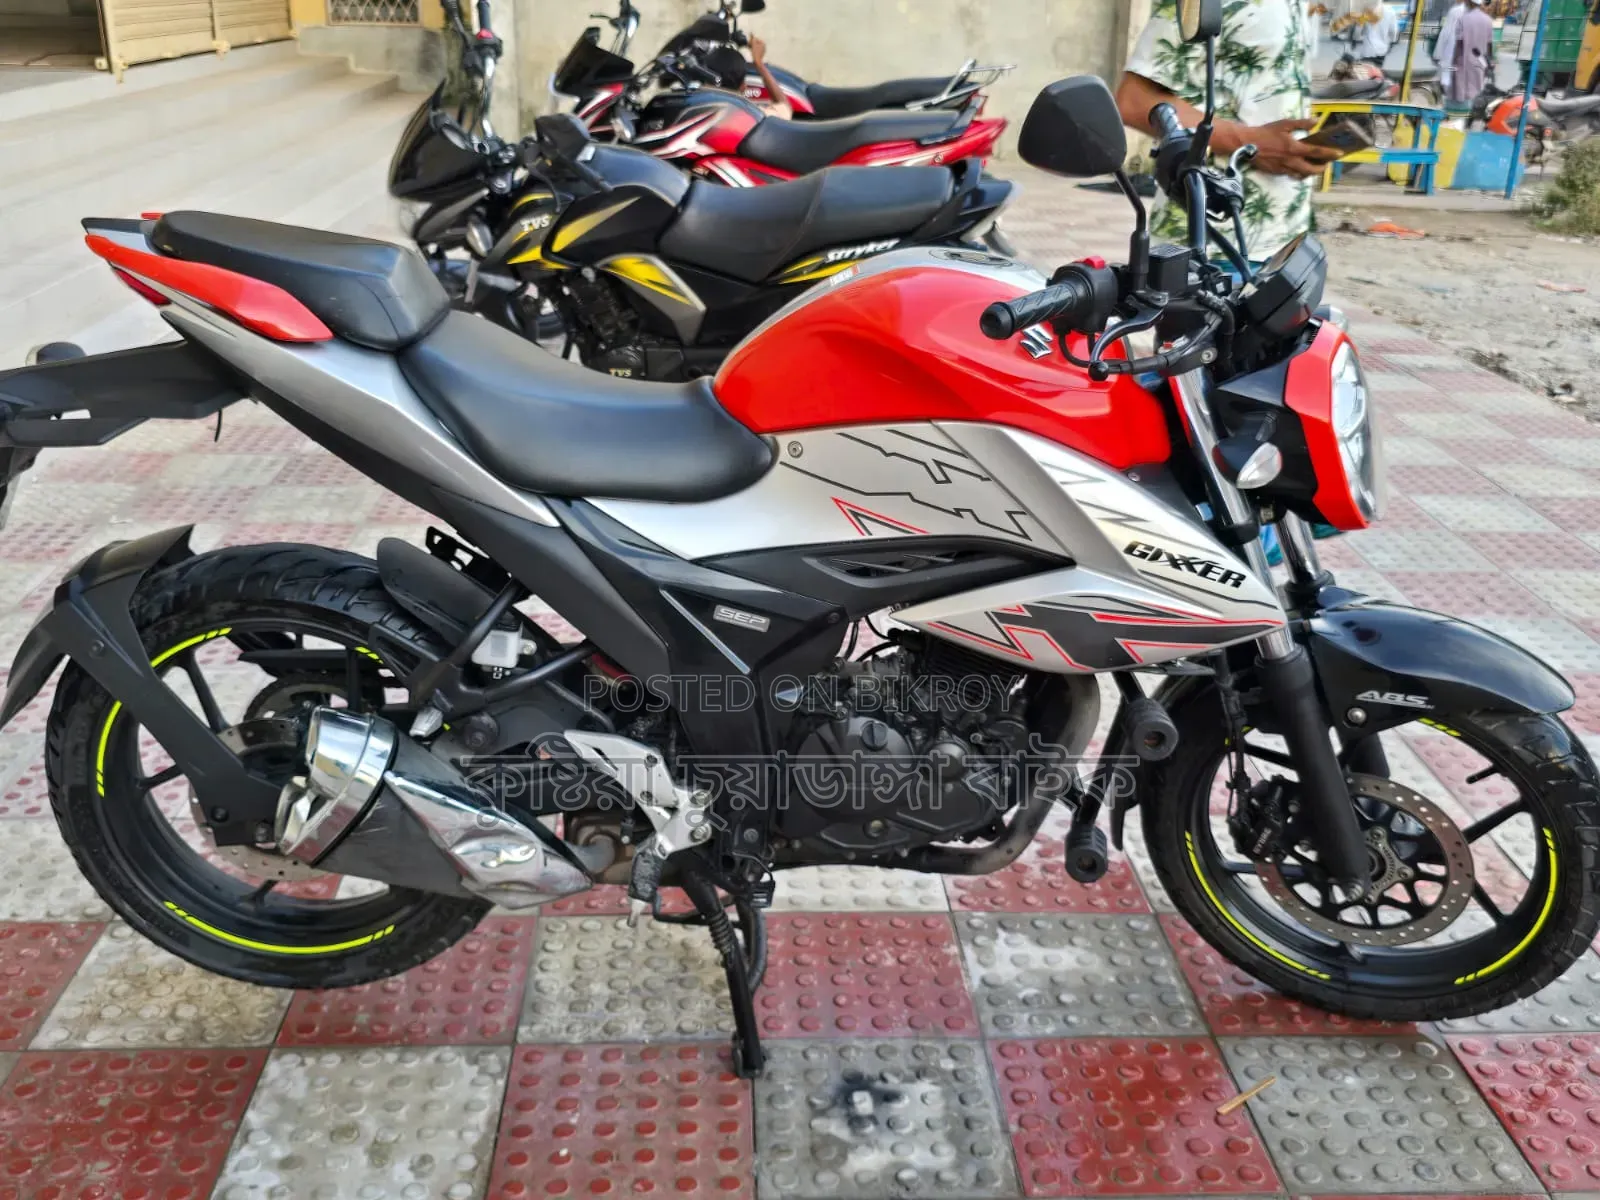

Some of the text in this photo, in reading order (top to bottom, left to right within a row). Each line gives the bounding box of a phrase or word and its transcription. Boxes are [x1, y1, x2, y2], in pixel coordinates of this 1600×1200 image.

[520, 214, 550, 232] TVS
[609, 367, 632, 377] TVS
[1123, 540, 1247, 589] GIXXER
[716, 607, 767, 624] SEP
[1355, 689, 1430, 706] ABS
